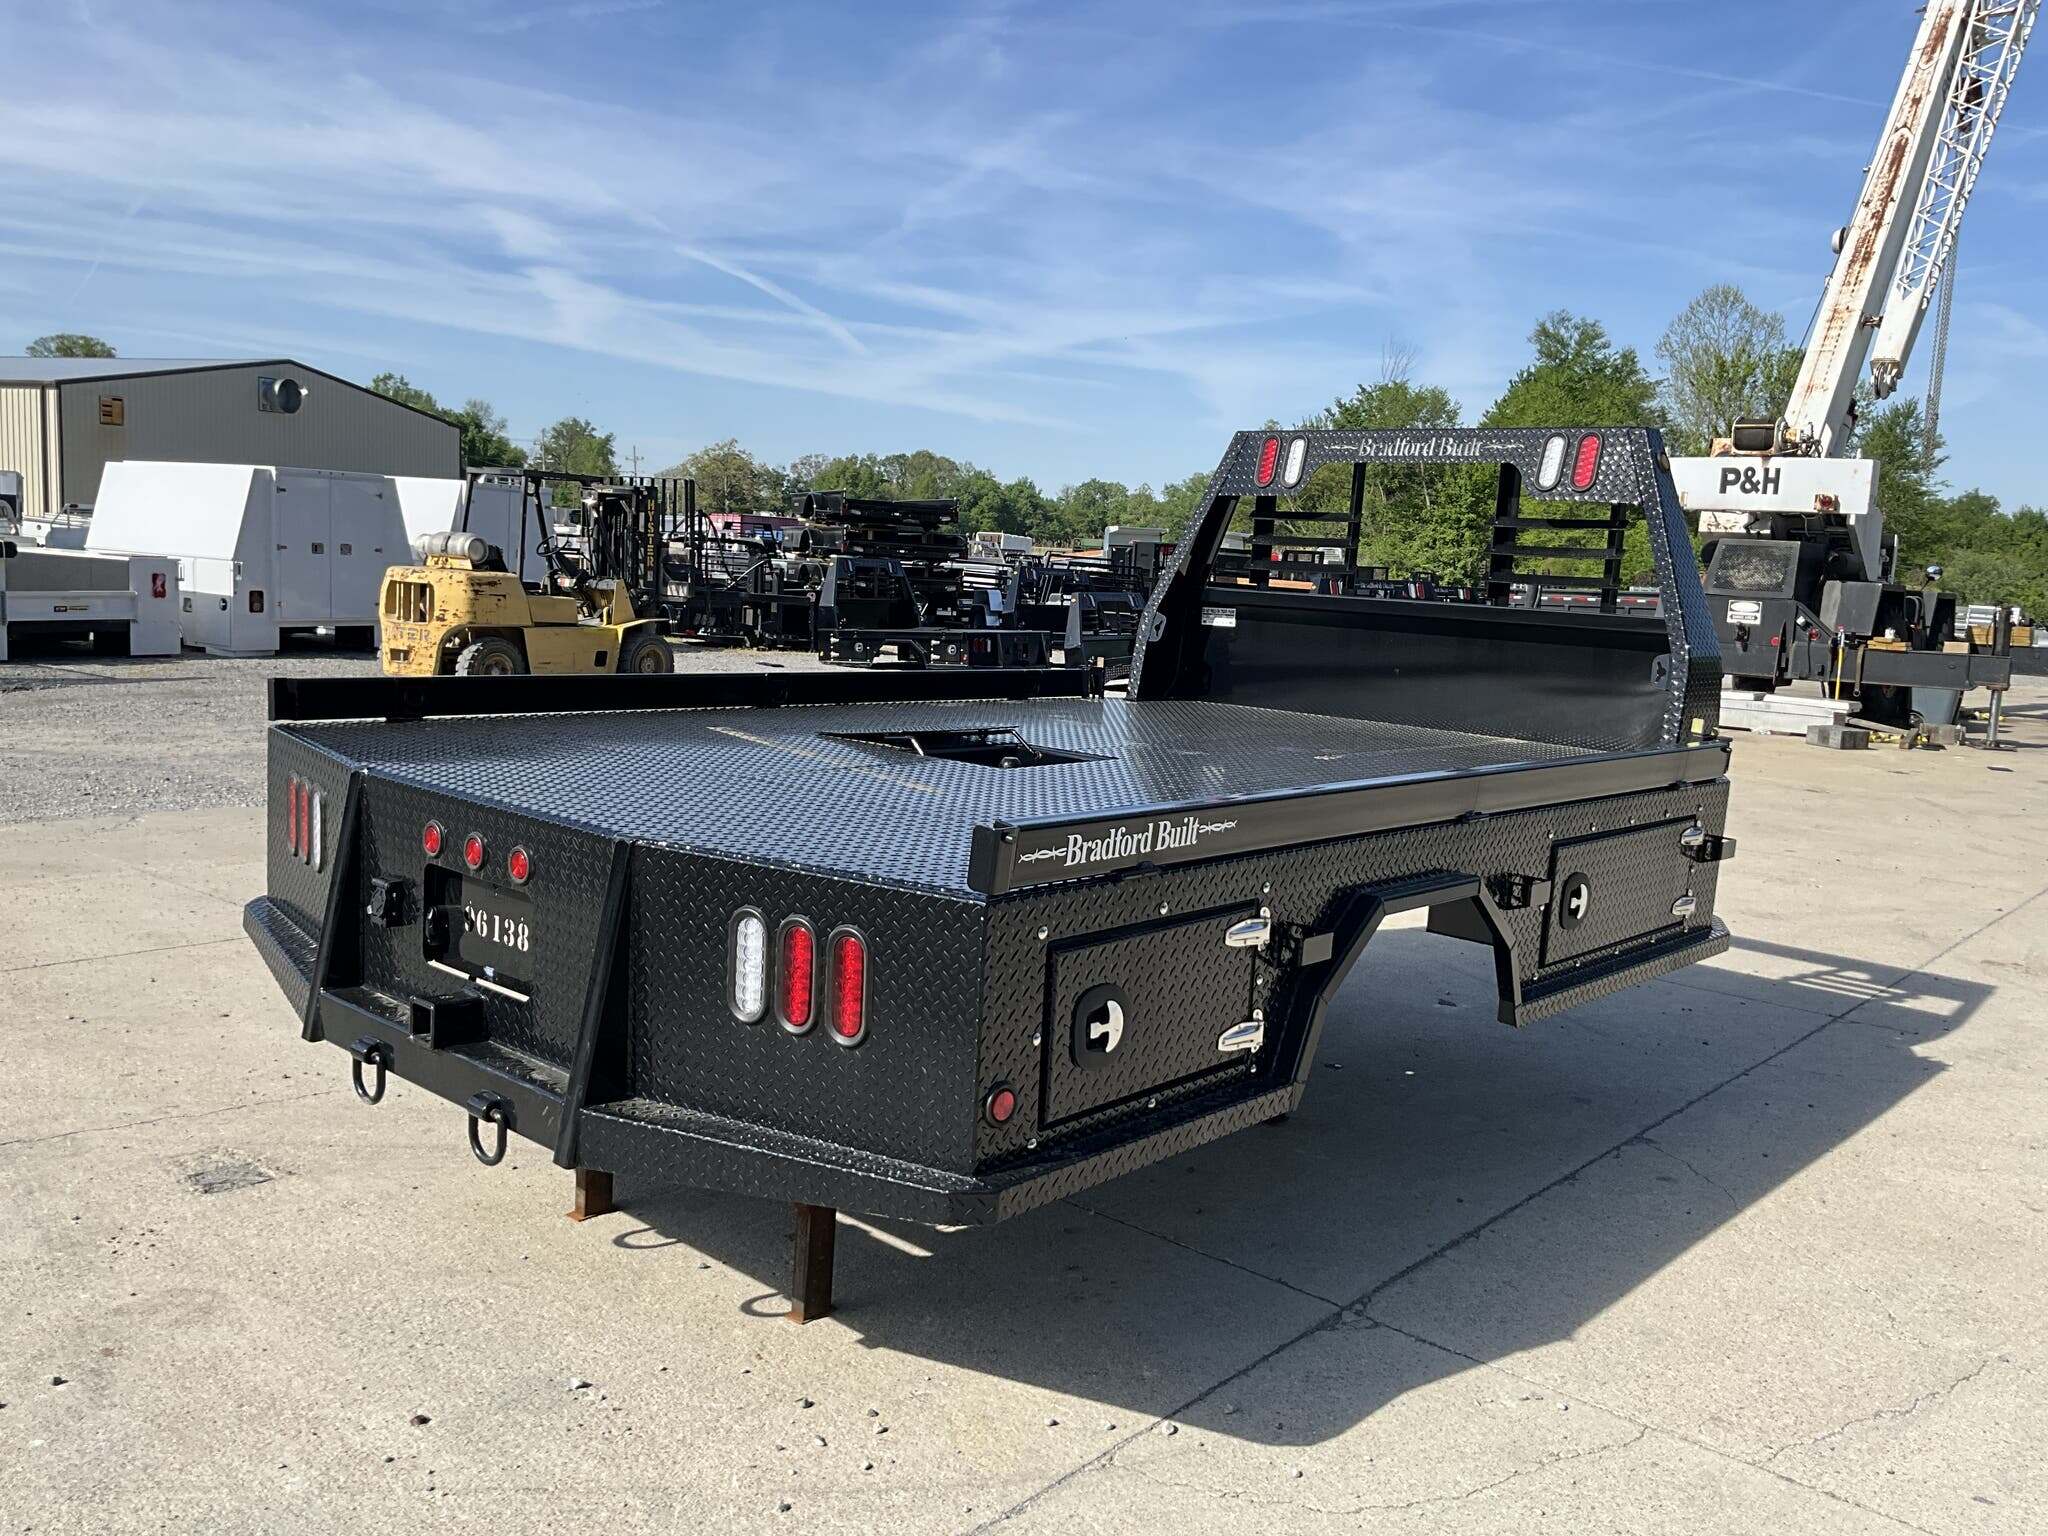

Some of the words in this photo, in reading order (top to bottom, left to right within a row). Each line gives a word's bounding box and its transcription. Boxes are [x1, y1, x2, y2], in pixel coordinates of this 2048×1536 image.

[1358, 437, 1436, 456] Bradford
[1439, 437, 1483, 456] Built
[1719, 467, 1781, 495] P&H
[647, 499, 655, 567] HYSTER
[1064, 823, 1152, 867] Bradford
[1154, 817, 1200, 851] Built
